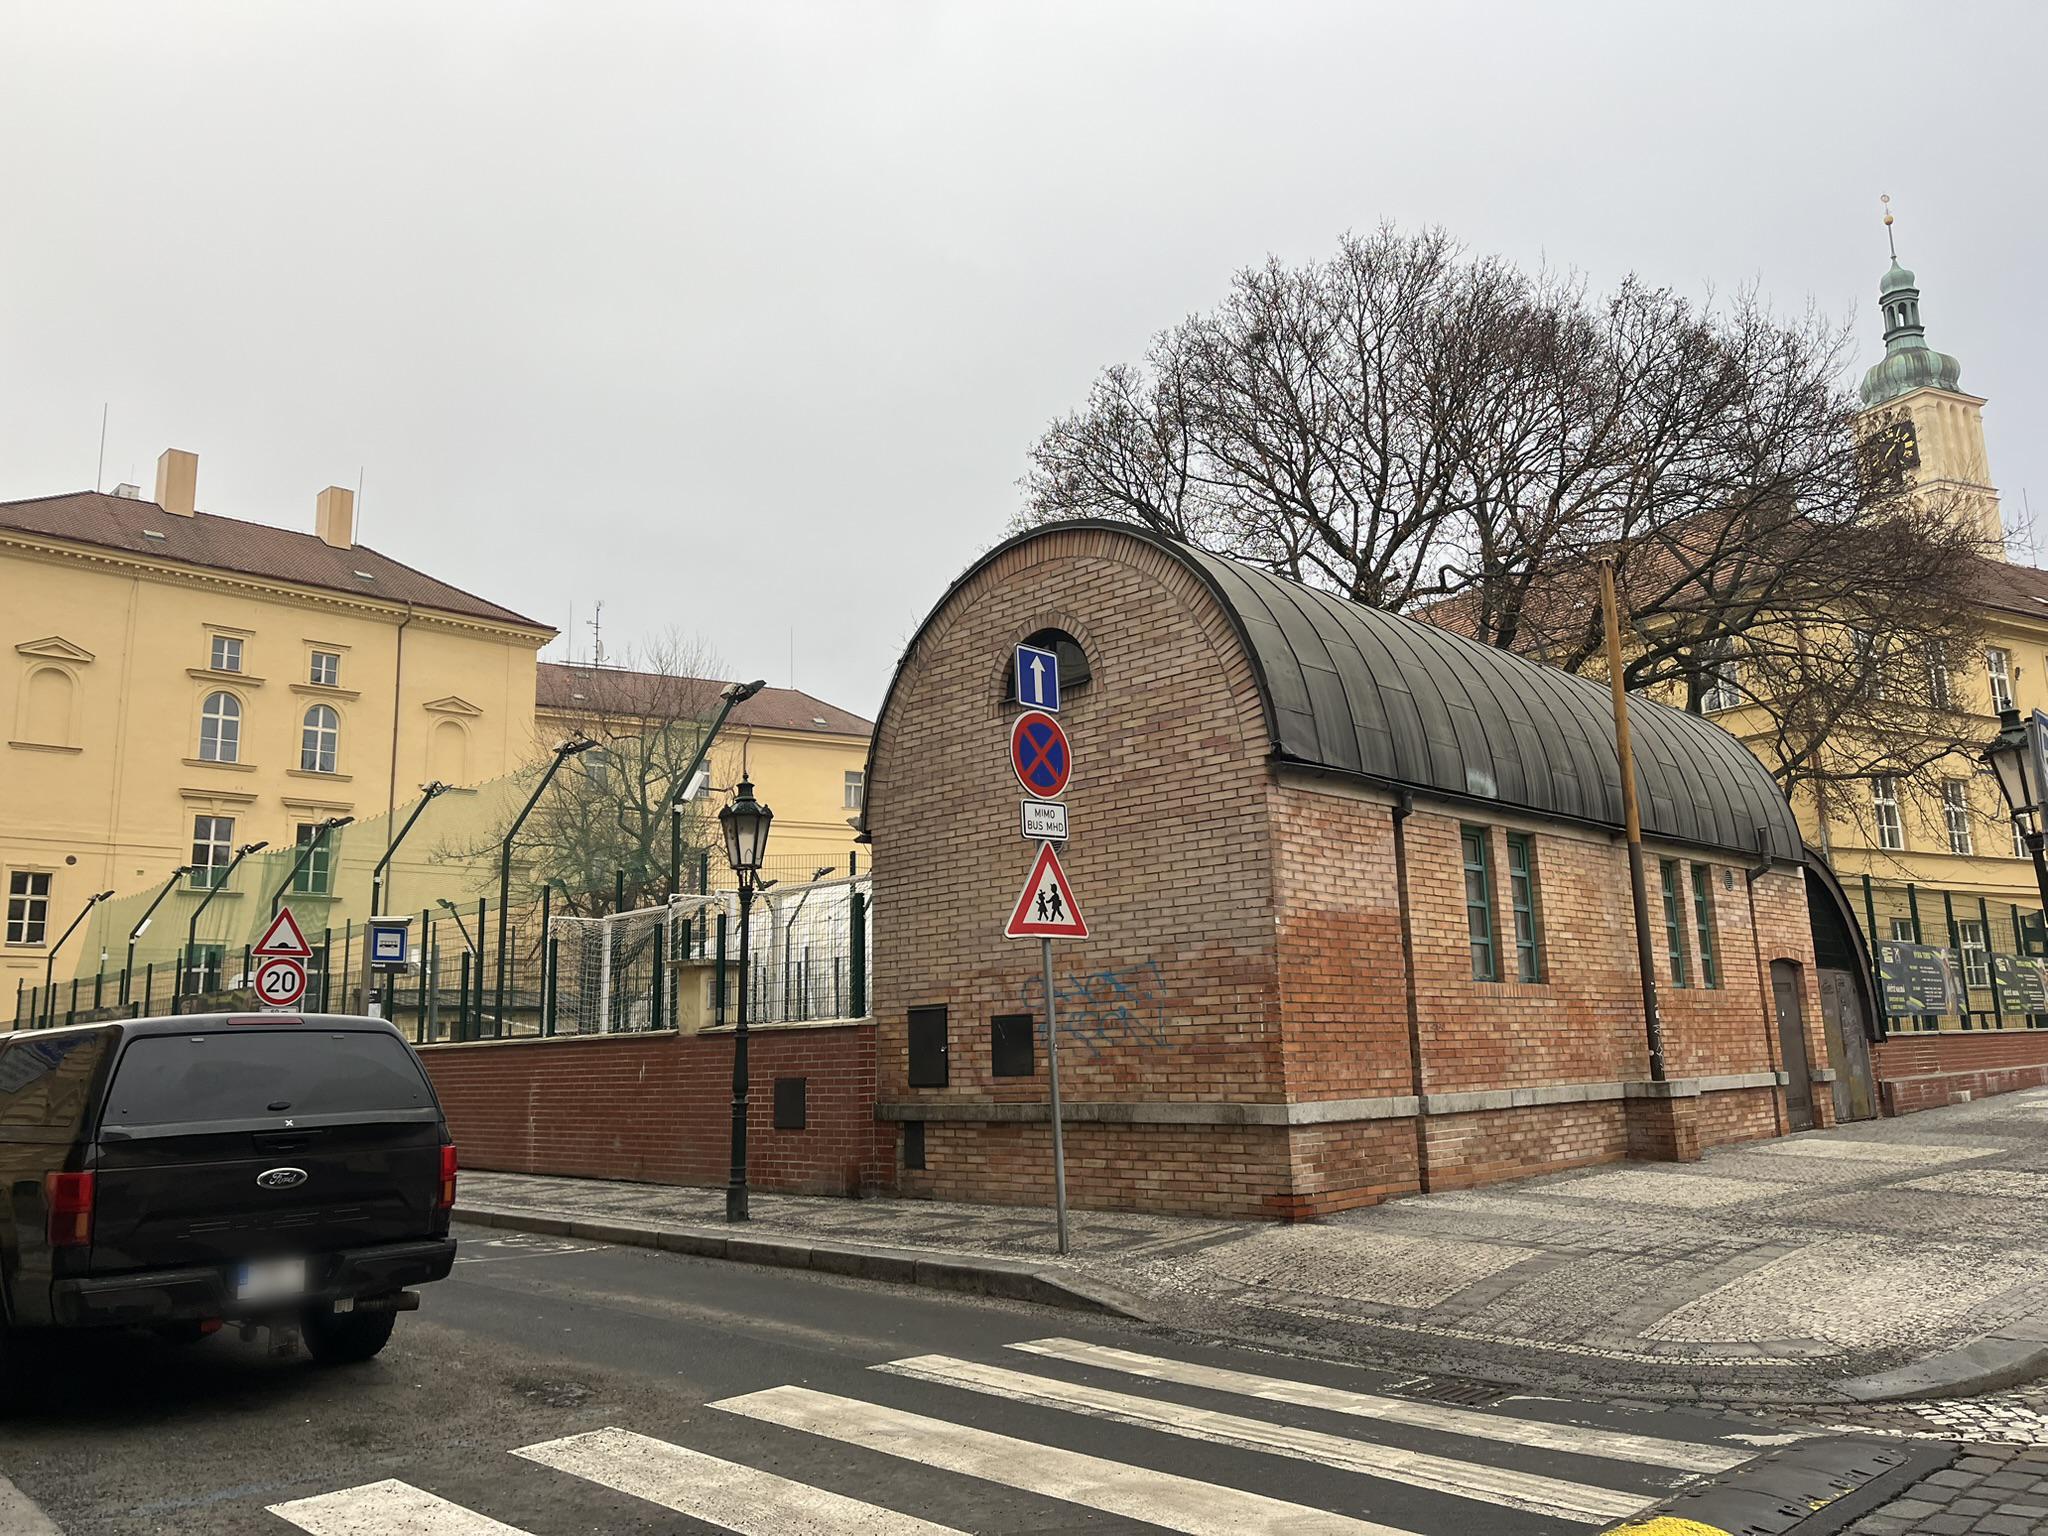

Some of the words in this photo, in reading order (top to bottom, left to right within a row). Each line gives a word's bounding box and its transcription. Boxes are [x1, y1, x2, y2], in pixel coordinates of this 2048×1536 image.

[1034, 808, 1056, 819] MIMO
[1027, 820, 1044, 831] BUS
[1046, 822, 1064, 832] MHD
[266, 971, 296, 992] 20
[269, 1172, 297, 1185] Ford
